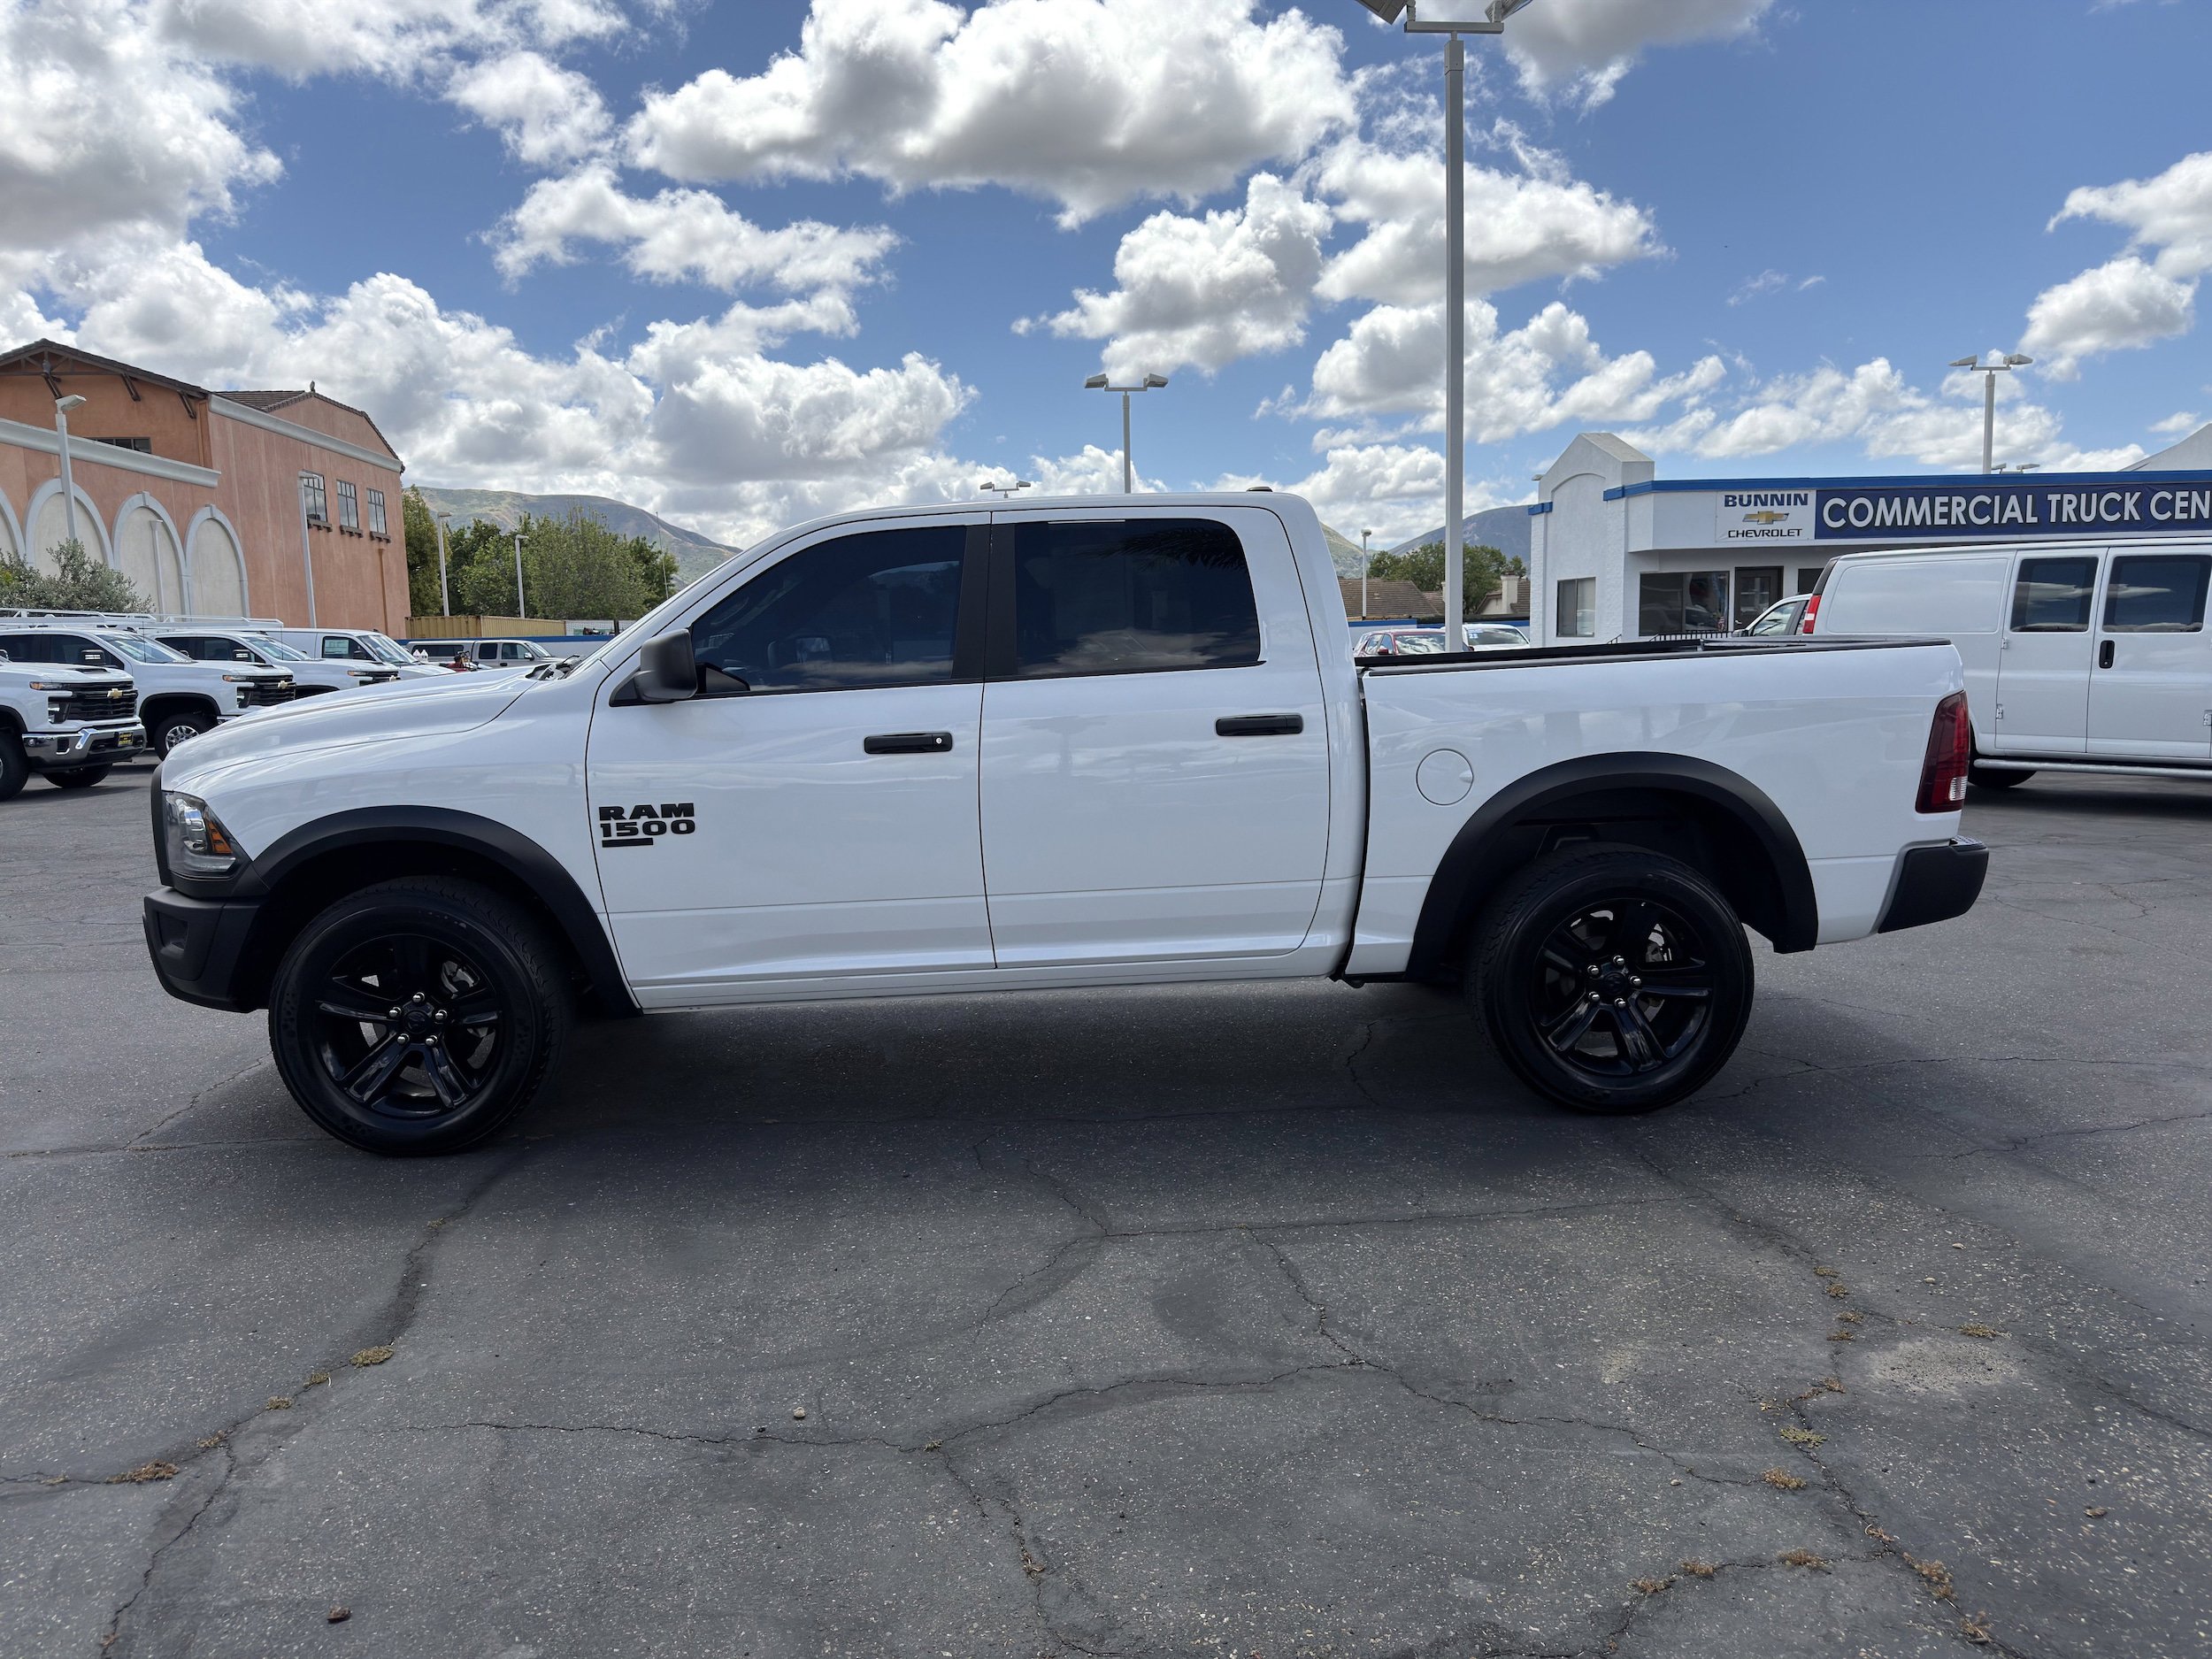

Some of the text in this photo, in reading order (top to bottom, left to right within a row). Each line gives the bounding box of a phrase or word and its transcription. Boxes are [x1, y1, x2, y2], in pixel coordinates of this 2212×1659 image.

[1724, 494, 1809, 507] BUNNIN
[1823, 490, 2211, 528] COMMERCIAL TRUCK CEN
[1728, 528, 1803, 539] CHEVROLET
[599, 803, 695, 821] RAM
[600, 819, 695, 837] 1500
